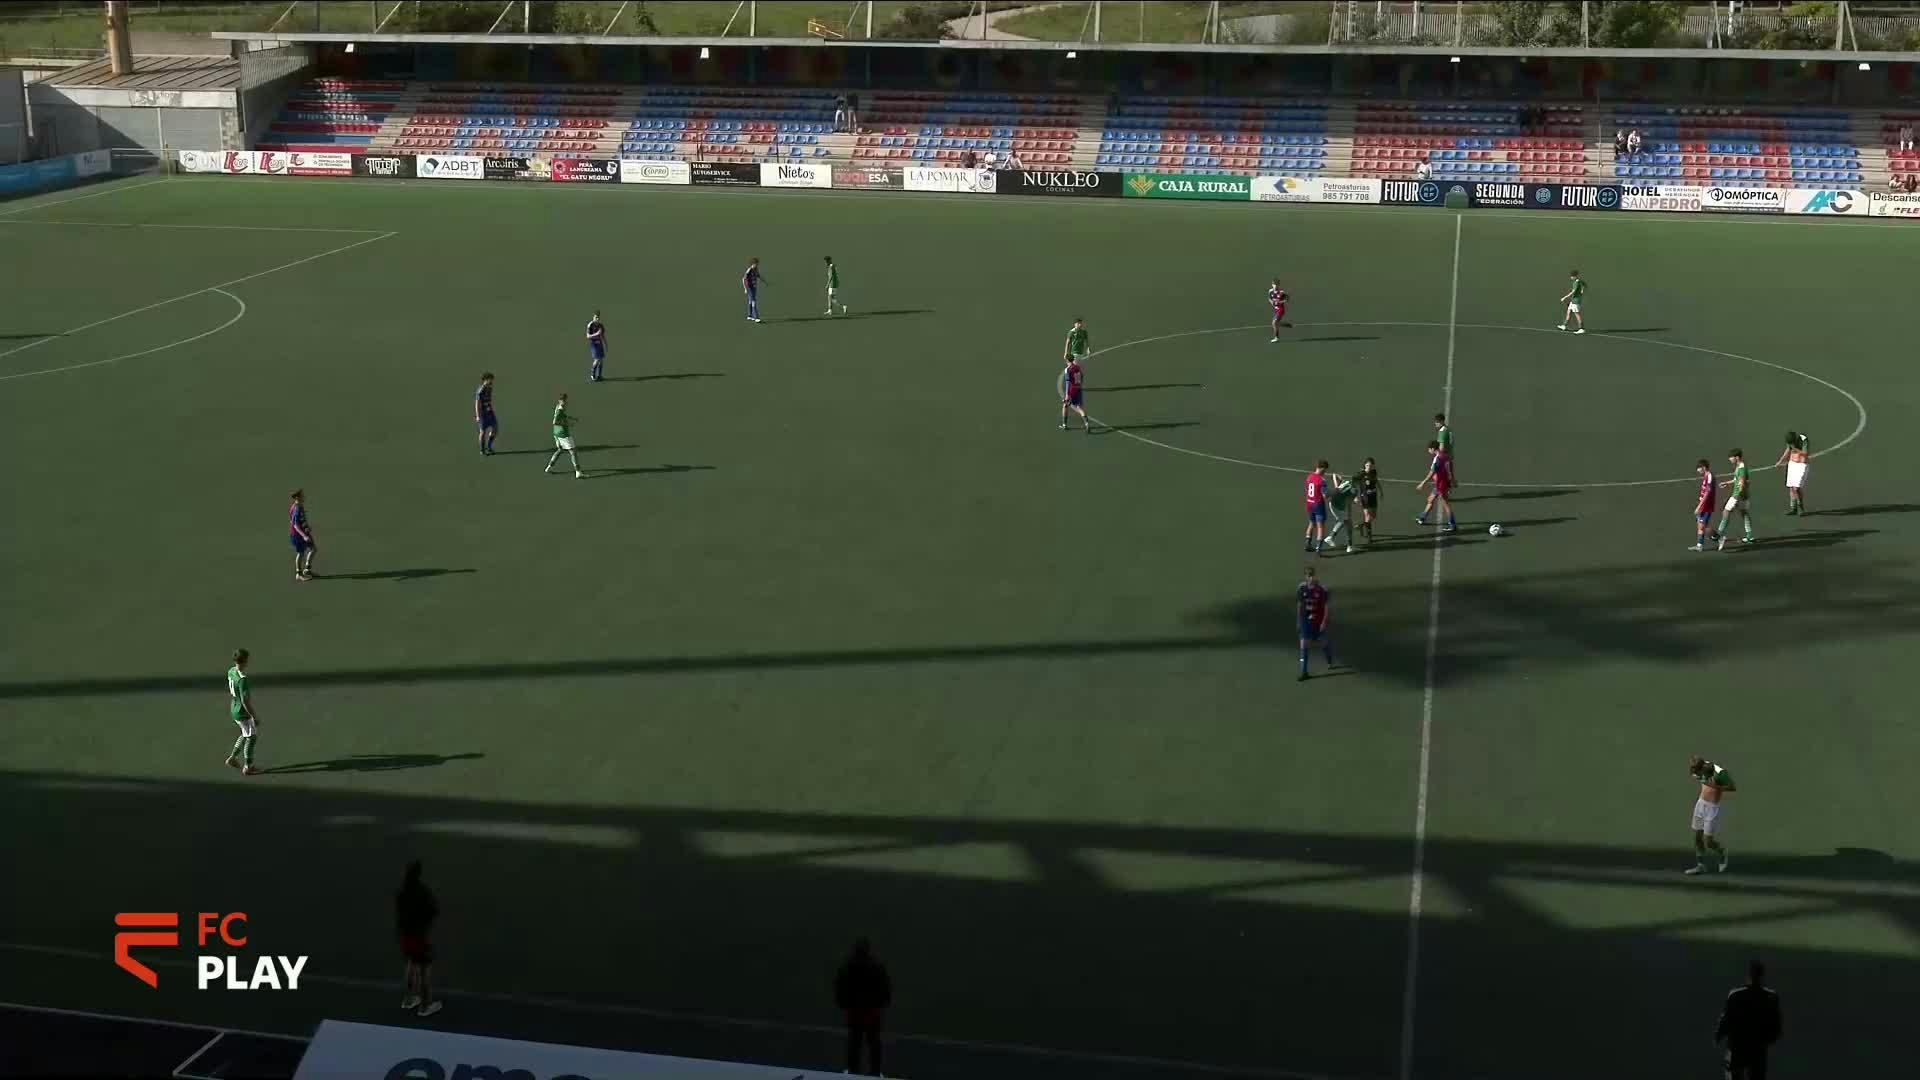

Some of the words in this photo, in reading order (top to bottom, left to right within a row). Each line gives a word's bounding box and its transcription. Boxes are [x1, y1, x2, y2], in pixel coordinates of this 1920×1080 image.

[441, 160, 479, 172] ADBT
[485, 158, 519, 169] Arcoiris
[778, 165, 815, 180] Nieto's
[910, 170, 924, 181] LA
[927, 170, 968, 182] POMAR
[1022, 172, 1100, 188] NUKLEO
[1158, 180, 1195, 192] CAJA
[1197, 181, 1248, 193] RURAL
[1323, 182, 1370, 191] Petroasturias
[1475, 183, 1525, 199] SEGUNDA
[1622, 186, 1661, 197] HOTEL
[1260, 193, 1310, 201] PETROASTURIAS
[1322, 192, 1337, 200] 985
[1339, 192, 1353, 200] 791
[1307, 482, 1315, 498] 8
